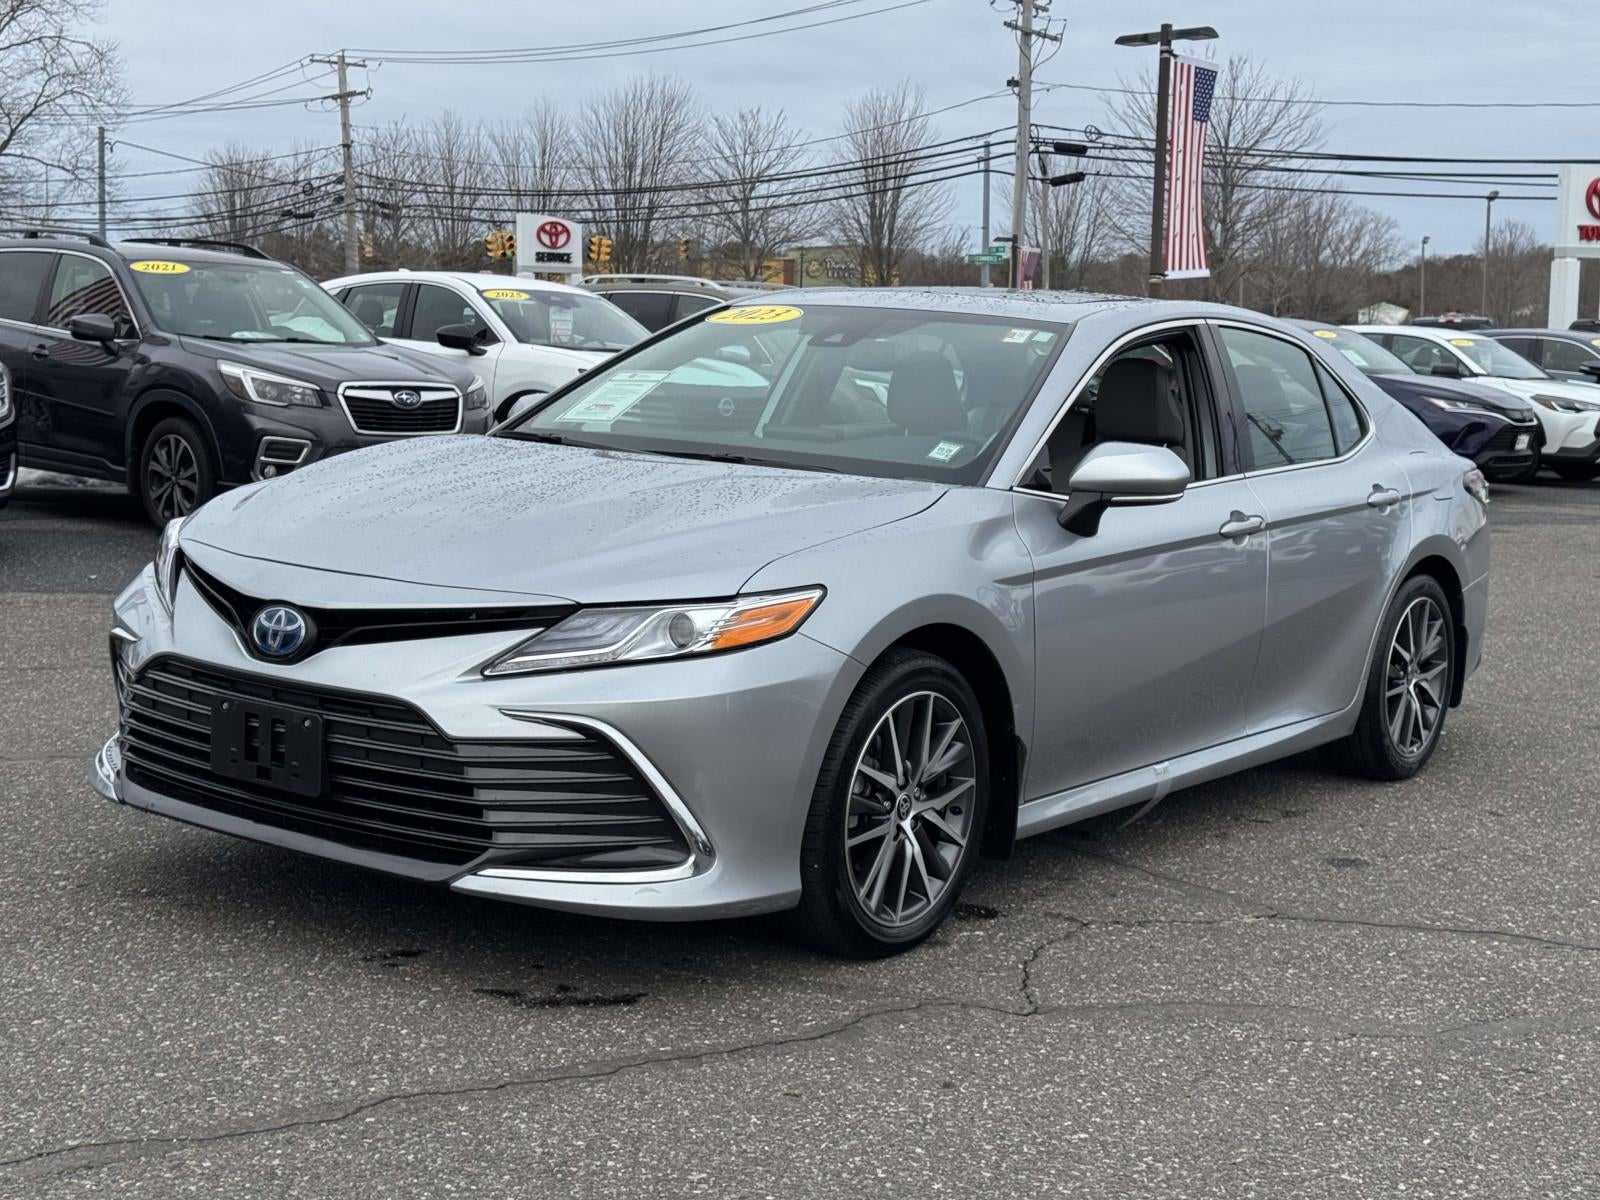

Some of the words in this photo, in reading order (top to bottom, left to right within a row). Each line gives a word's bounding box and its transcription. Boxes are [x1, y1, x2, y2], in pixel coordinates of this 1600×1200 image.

[535, 252, 573, 264] SERVICE
[142, 263, 176, 271] 2021
[717, 308, 793, 321] 2023
